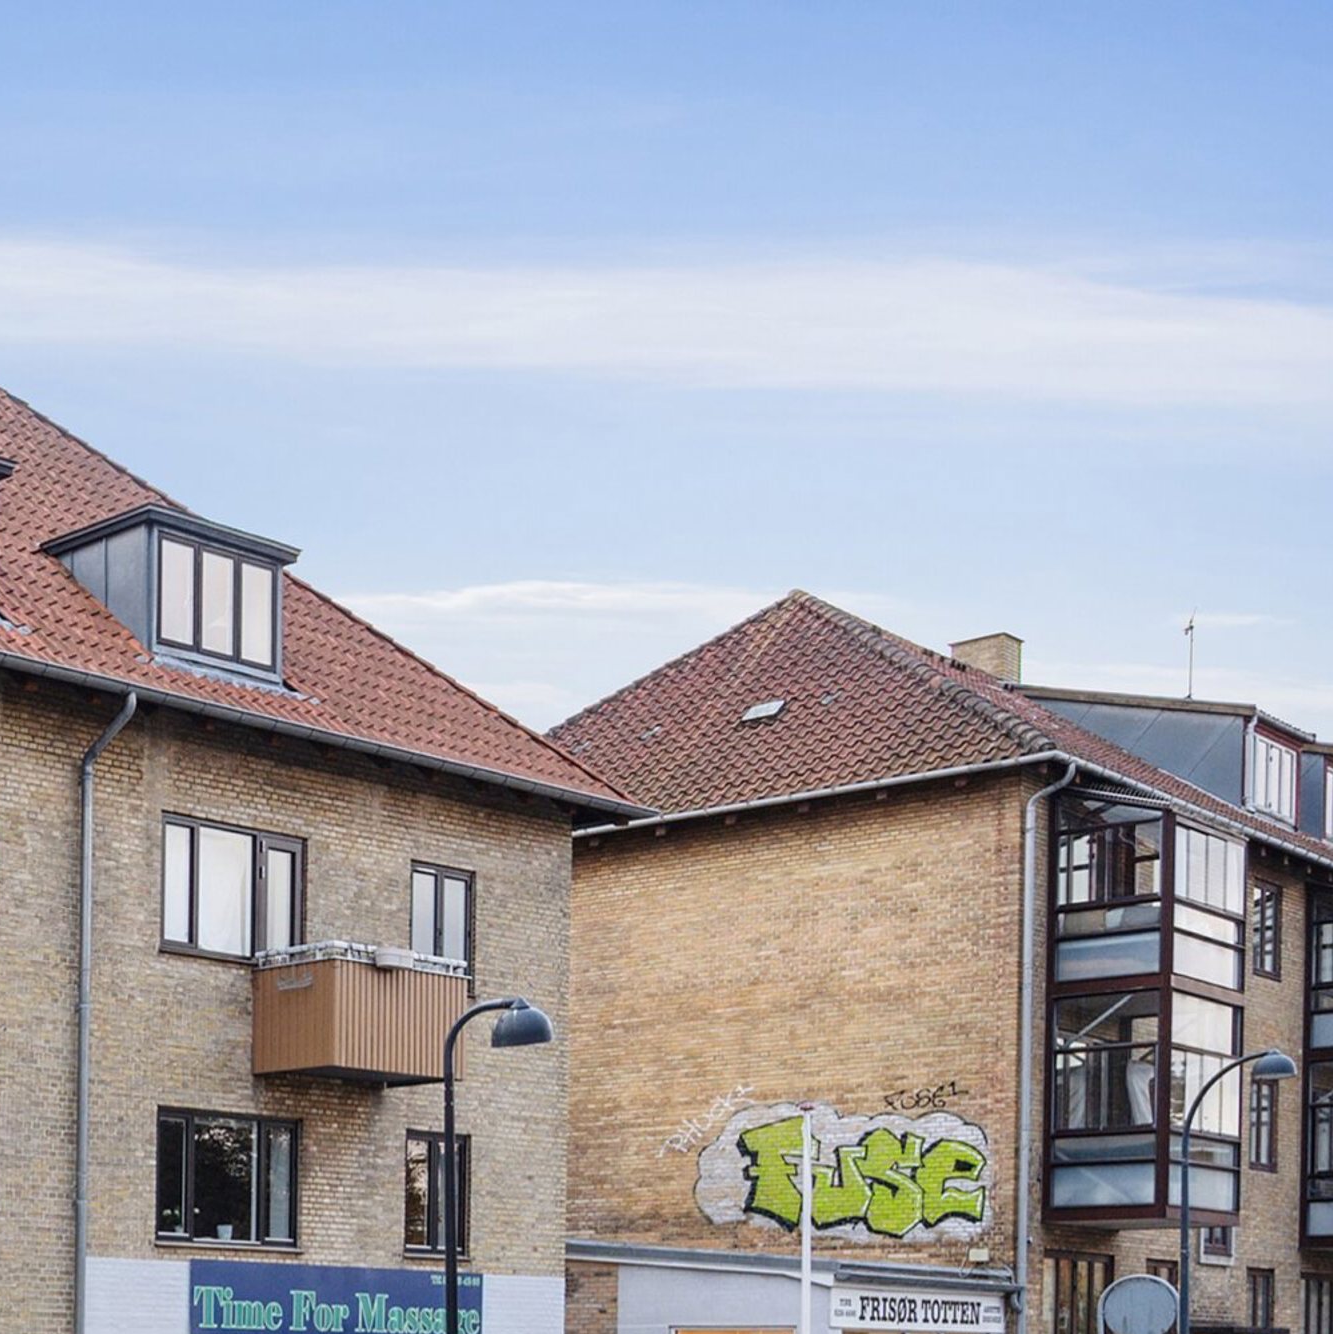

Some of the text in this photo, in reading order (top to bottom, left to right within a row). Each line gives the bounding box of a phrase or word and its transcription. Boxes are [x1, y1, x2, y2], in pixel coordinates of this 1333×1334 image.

[194, 1285, 283, 1330] Time
[289, 1289, 350, 1332] For
[859, 1295, 982, 1325] FRISØR TOTTEN
